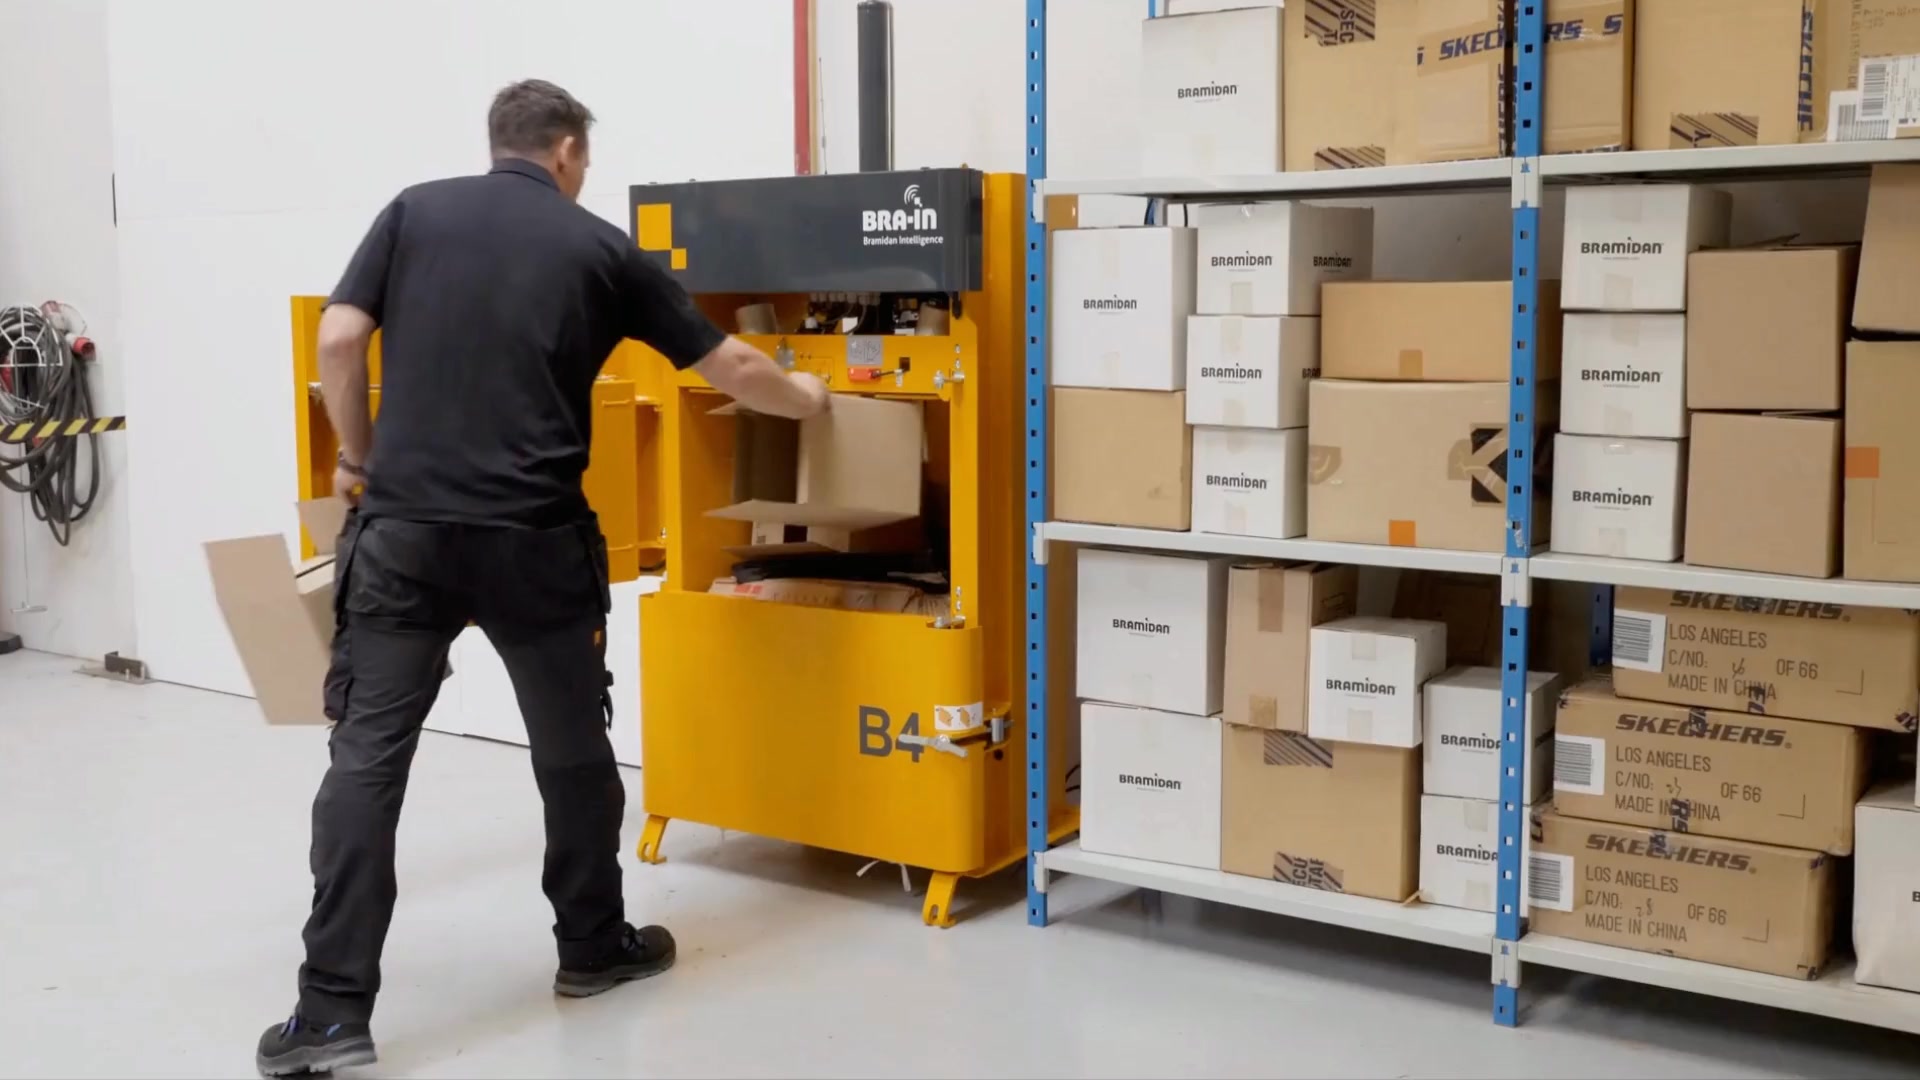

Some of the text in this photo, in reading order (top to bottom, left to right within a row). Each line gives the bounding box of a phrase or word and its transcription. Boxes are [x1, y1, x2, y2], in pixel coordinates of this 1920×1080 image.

[863, 234, 944, 247] Bramidan Intelligence
[1669, 623, 1767, 649] LOS ANGELES
[1776, 658, 1795, 677] OF
[1798, 661, 1819, 680] 66
[1668, 673, 1708, 692] MADE
[1714, 677, 1728, 694] IN
[859, 705, 925, 763] B4
[1615, 745, 1712, 773] LOS ANGELES
[1614, 794, 1653, 814] MADE
[1720, 782, 1739, 800] OF
[1742, 785, 1762, 803] 66
[1585, 864, 1679, 893] LOS ANGELES
[1687, 902, 1705, 921] OF
[1708, 907, 1727, 925] 66
[1585, 913, 1688, 942] MADE IN CHINA
